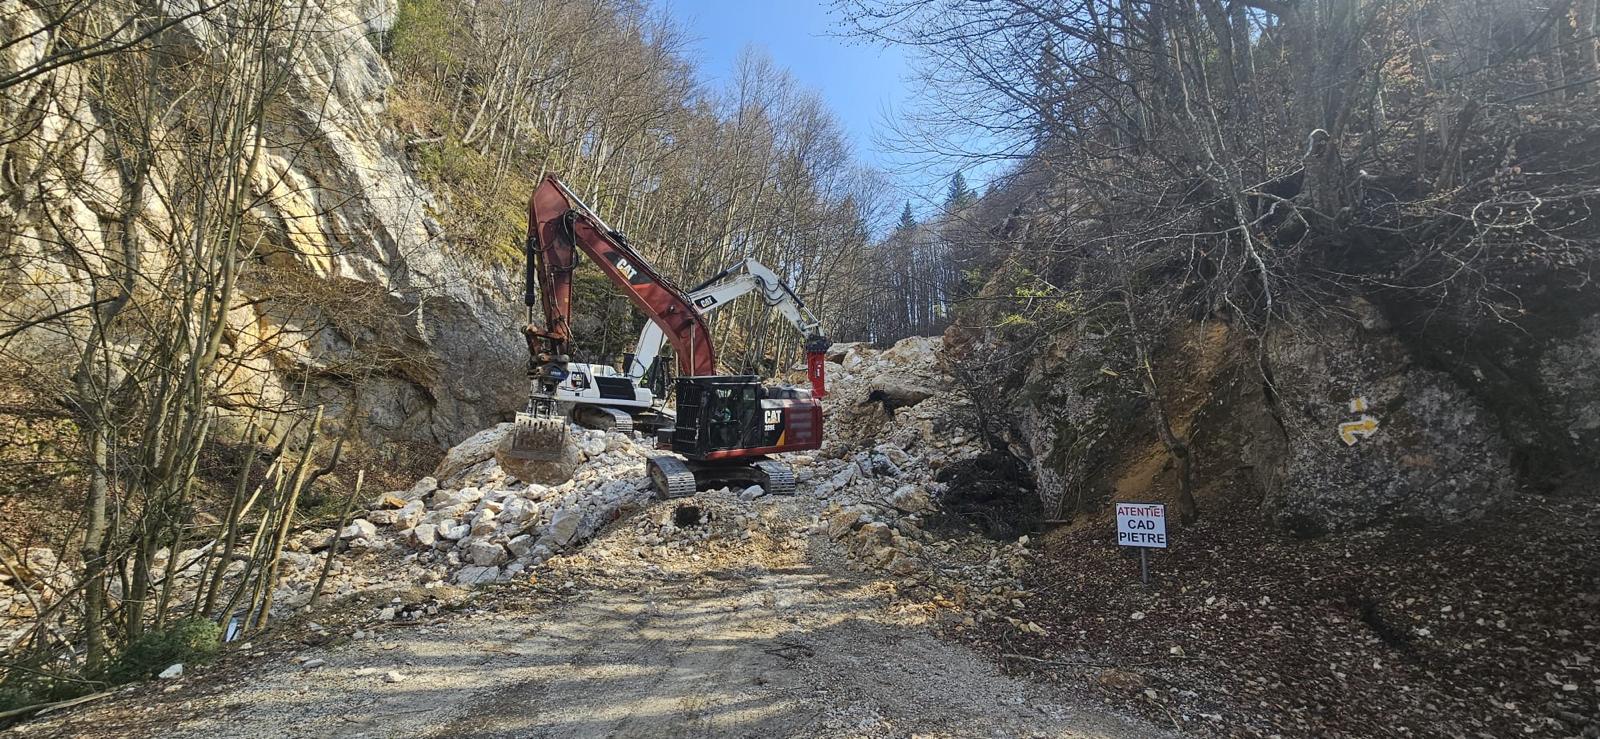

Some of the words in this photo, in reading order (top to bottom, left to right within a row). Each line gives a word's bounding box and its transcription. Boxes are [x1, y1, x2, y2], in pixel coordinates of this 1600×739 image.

[616, 258, 638, 280] CAT
[700, 296, 713, 308] CAT
[764, 410, 782, 425] CAT
[1128, 519, 1155, 530] CAD
[1120, 532, 1166, 544] PIETRE
